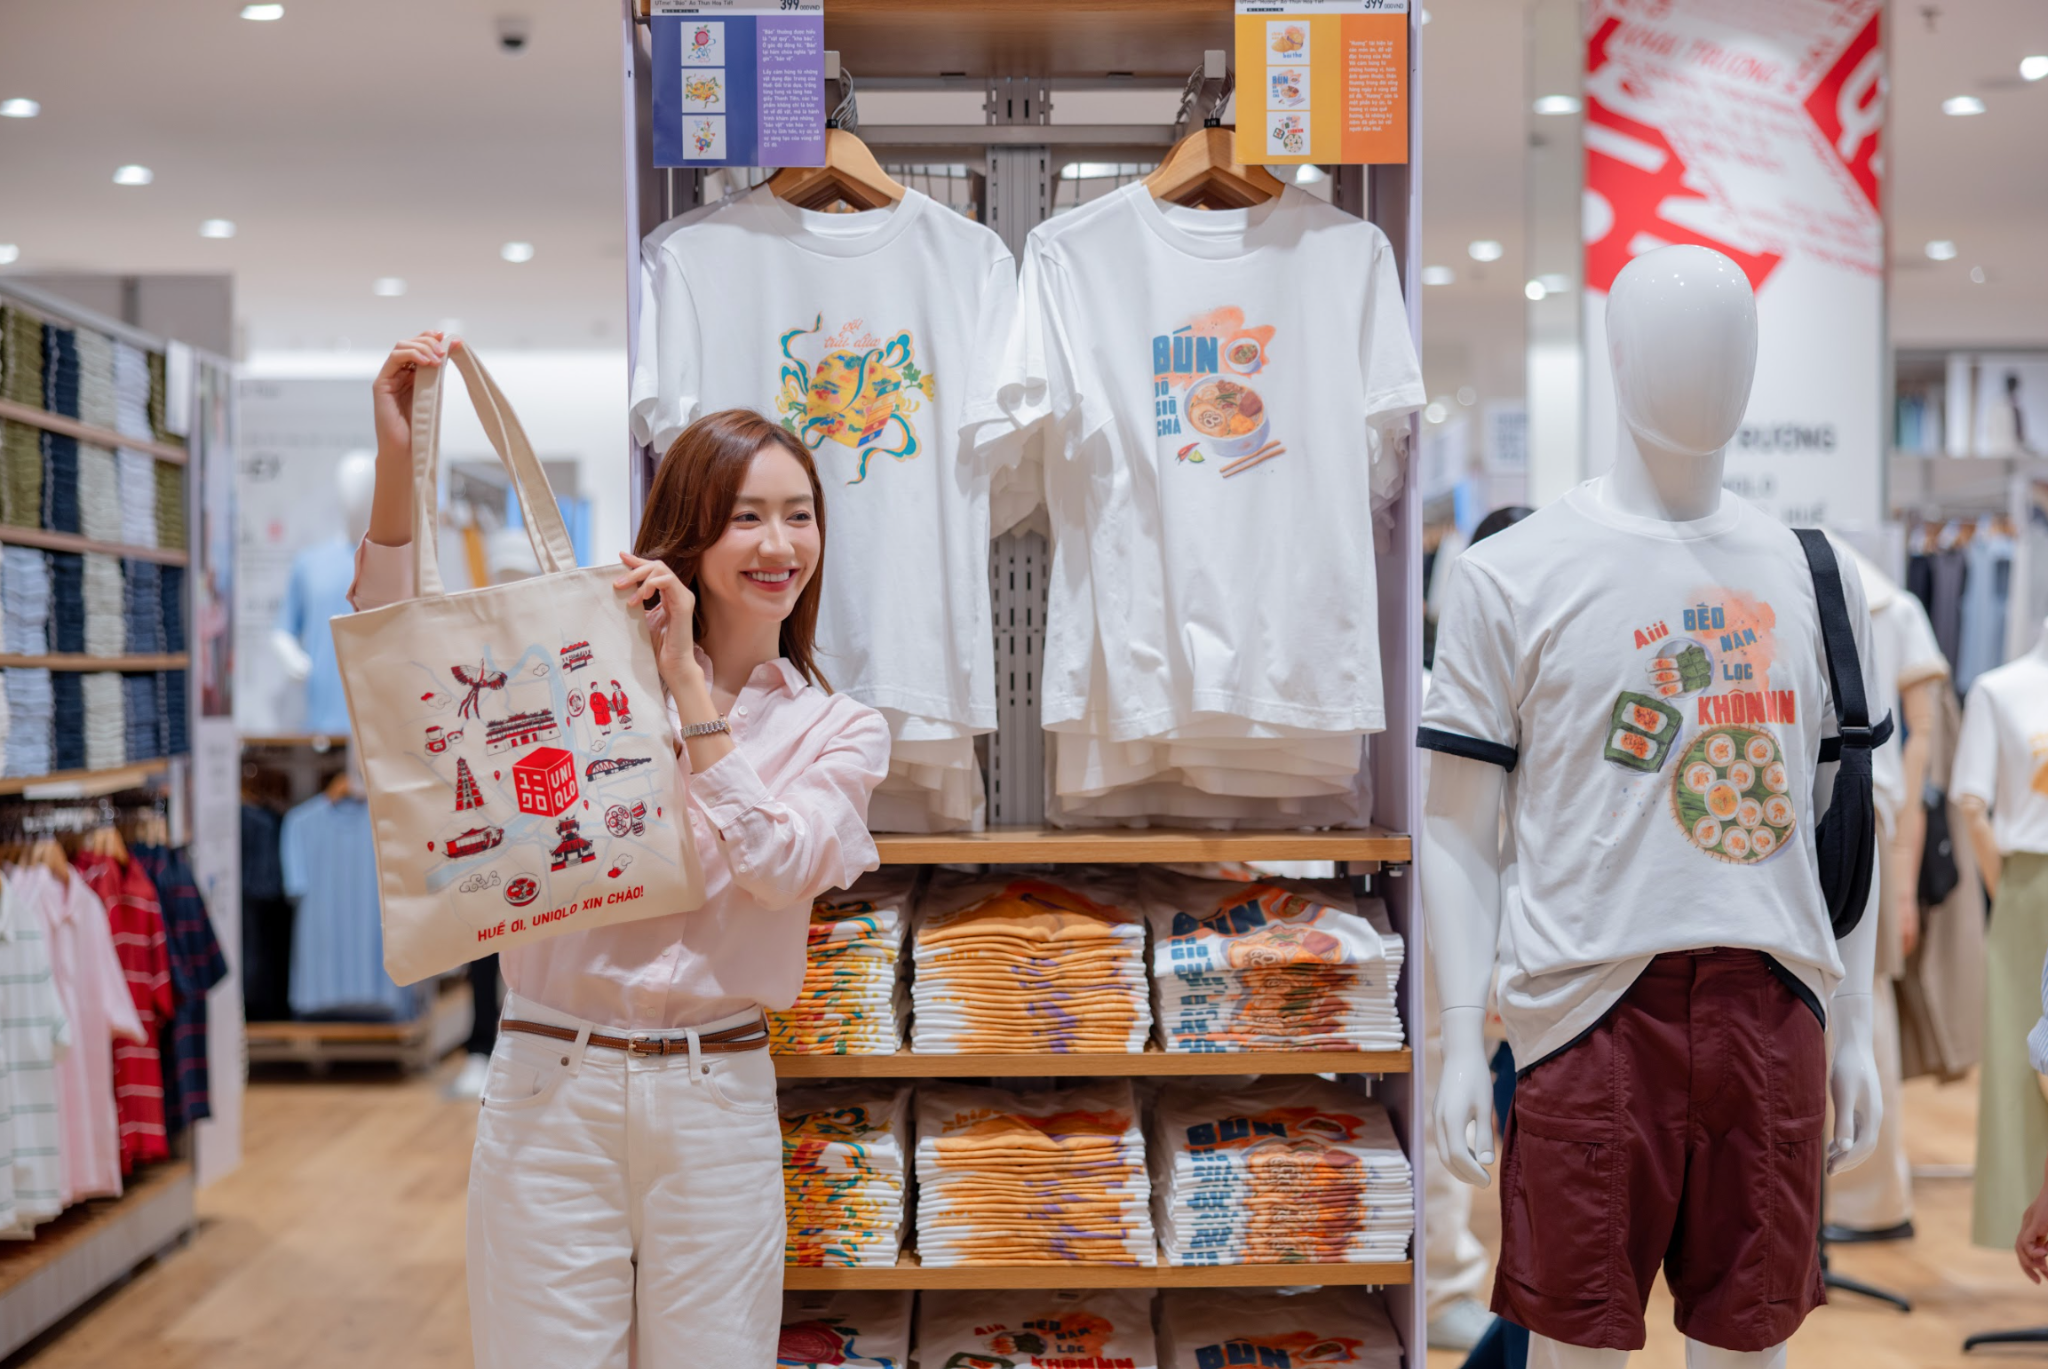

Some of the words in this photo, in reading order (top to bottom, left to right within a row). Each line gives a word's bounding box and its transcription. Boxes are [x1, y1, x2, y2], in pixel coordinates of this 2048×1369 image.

[780, 0, 799, 10] 399
[1364, 0, 1383, 8] 399
[1153, 324, 1218, 375] BÚN
[1634, 620, 1669, 650] Aiii
[551, 762, 573, 789] UNI
[554, 781, 577, 809] QLO
[478, 919, 506, 941] HUẾ
[532, 903, 578, 926] UNIQLO
[582, 896, 603, 911] XIN
